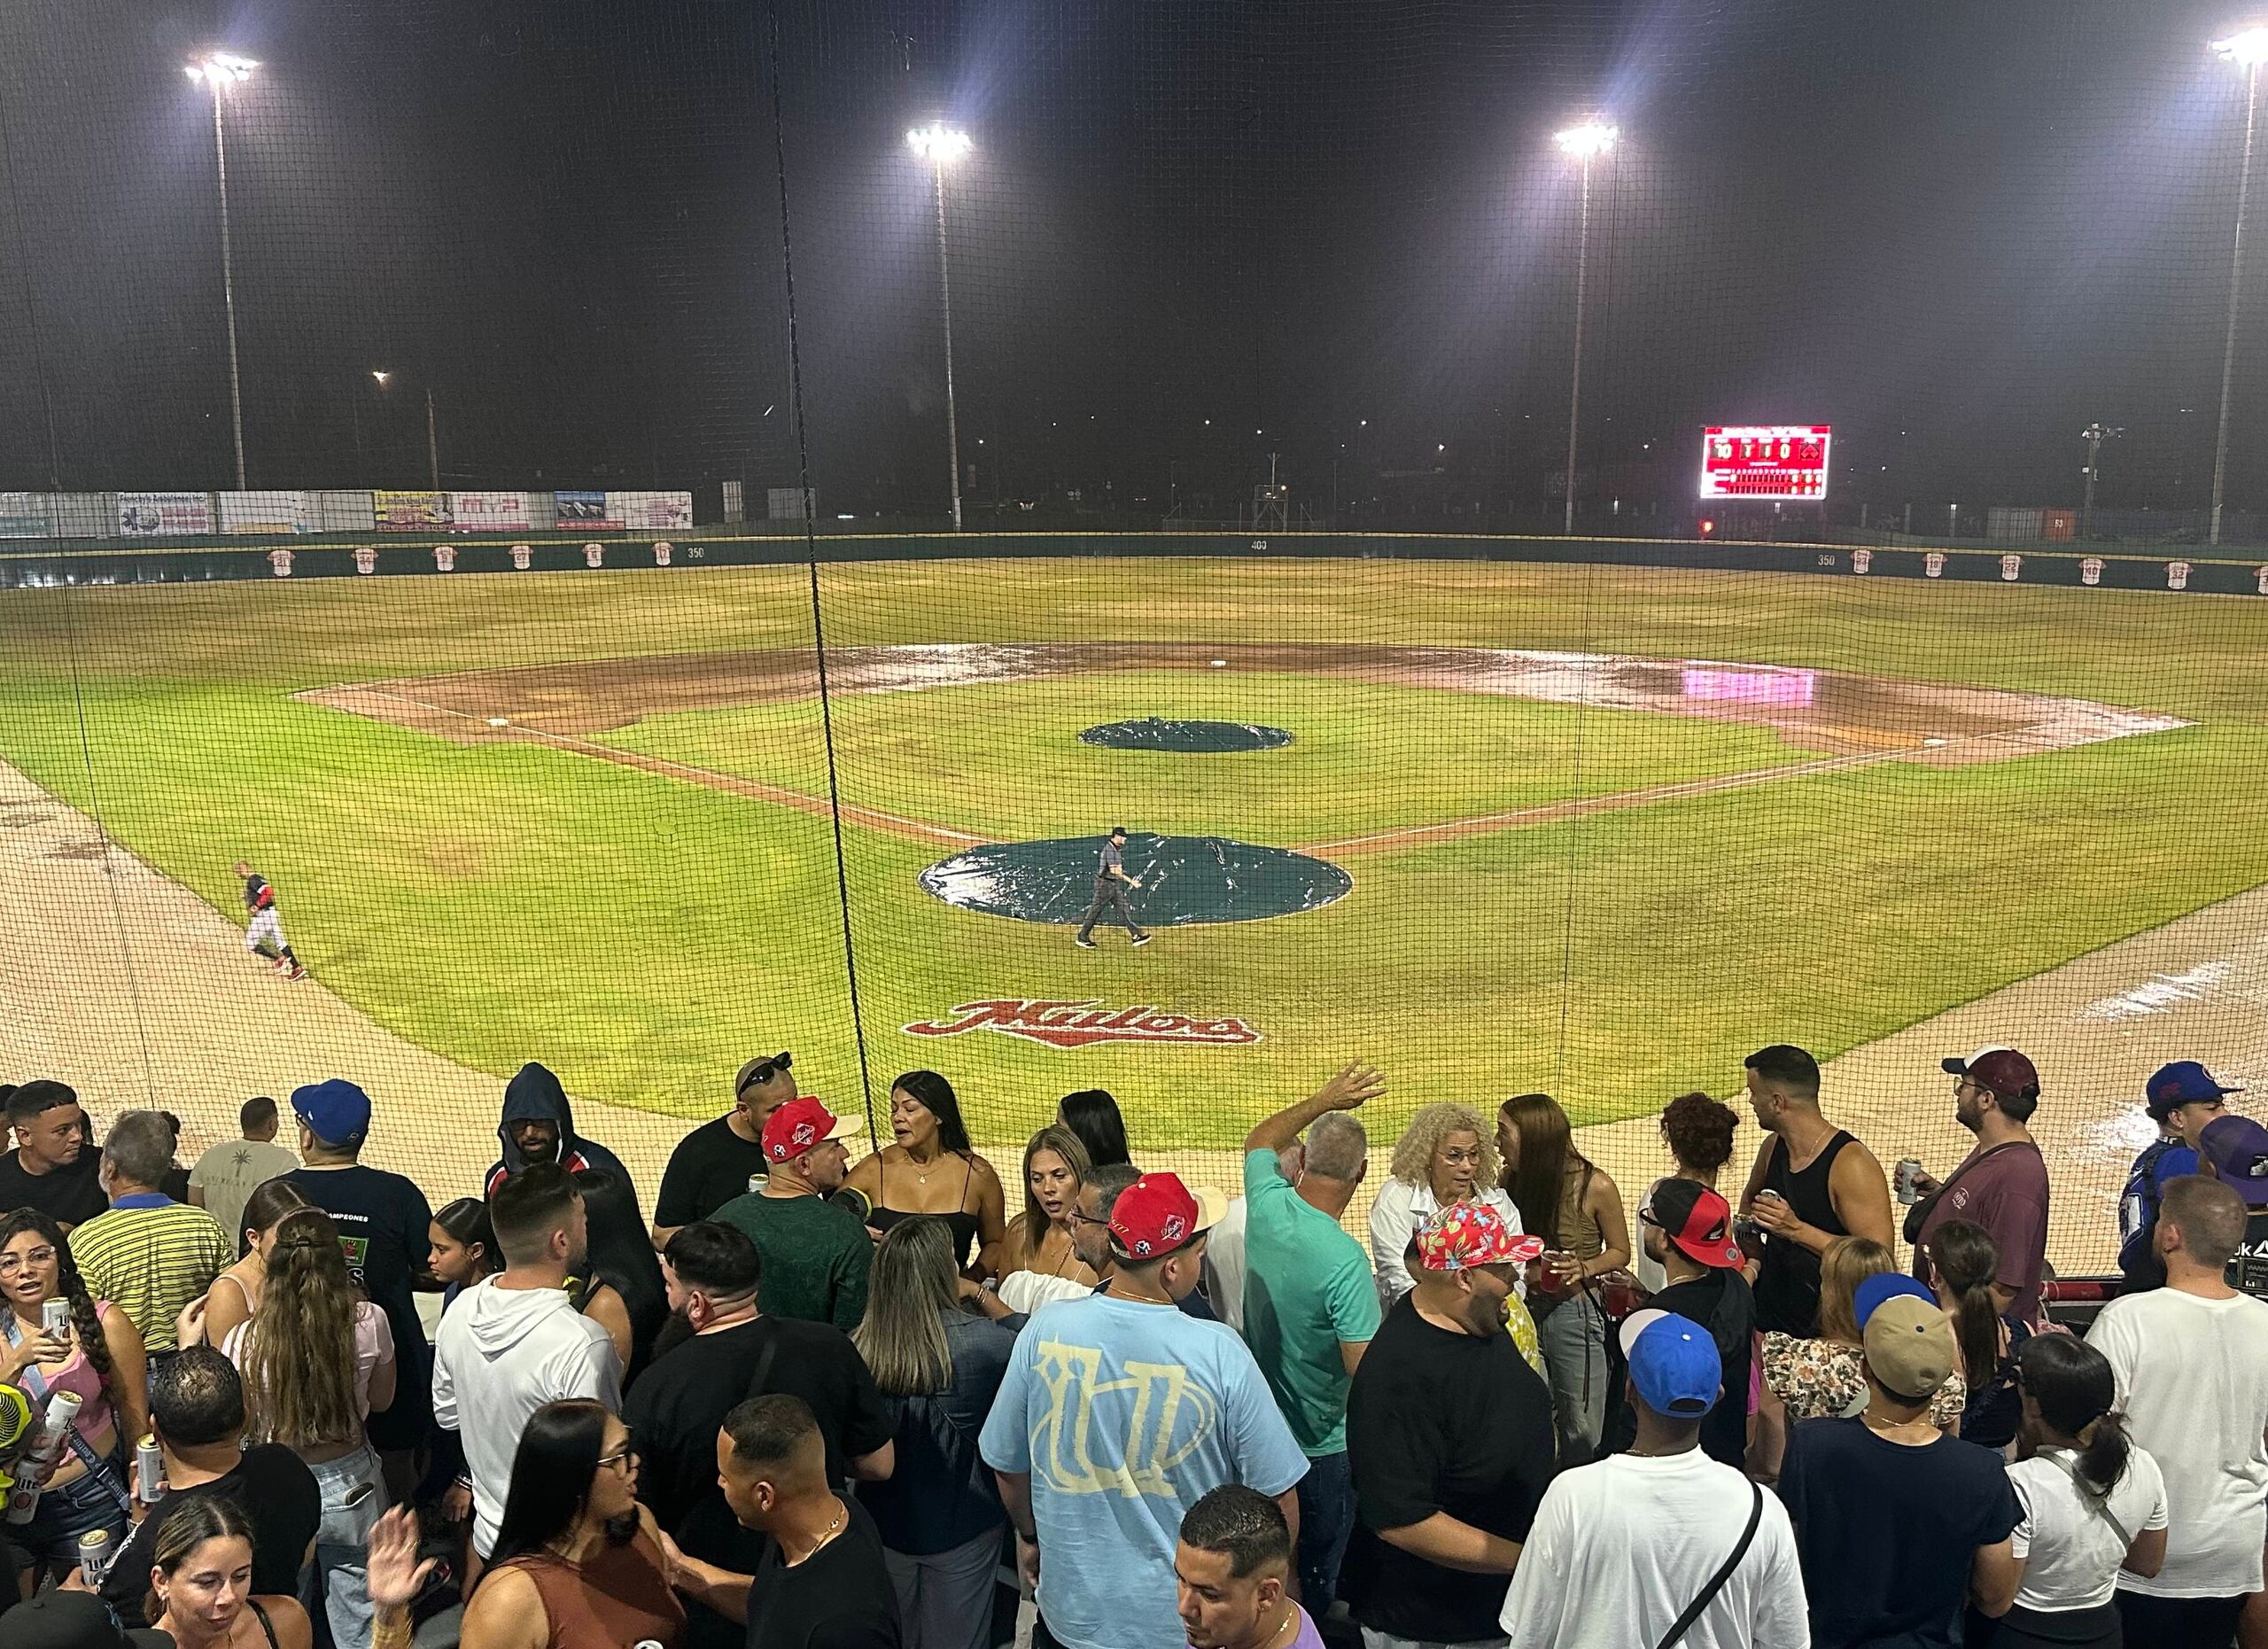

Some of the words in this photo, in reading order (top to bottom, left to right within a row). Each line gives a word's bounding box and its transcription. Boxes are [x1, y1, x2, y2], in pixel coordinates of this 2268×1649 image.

[1251, 541, 1267, 550] 400
[687, 547, 705, 558] 350
[1818, 555, 1836, 566] 350
[327, 1212, 369, 1223] AMPEONES
